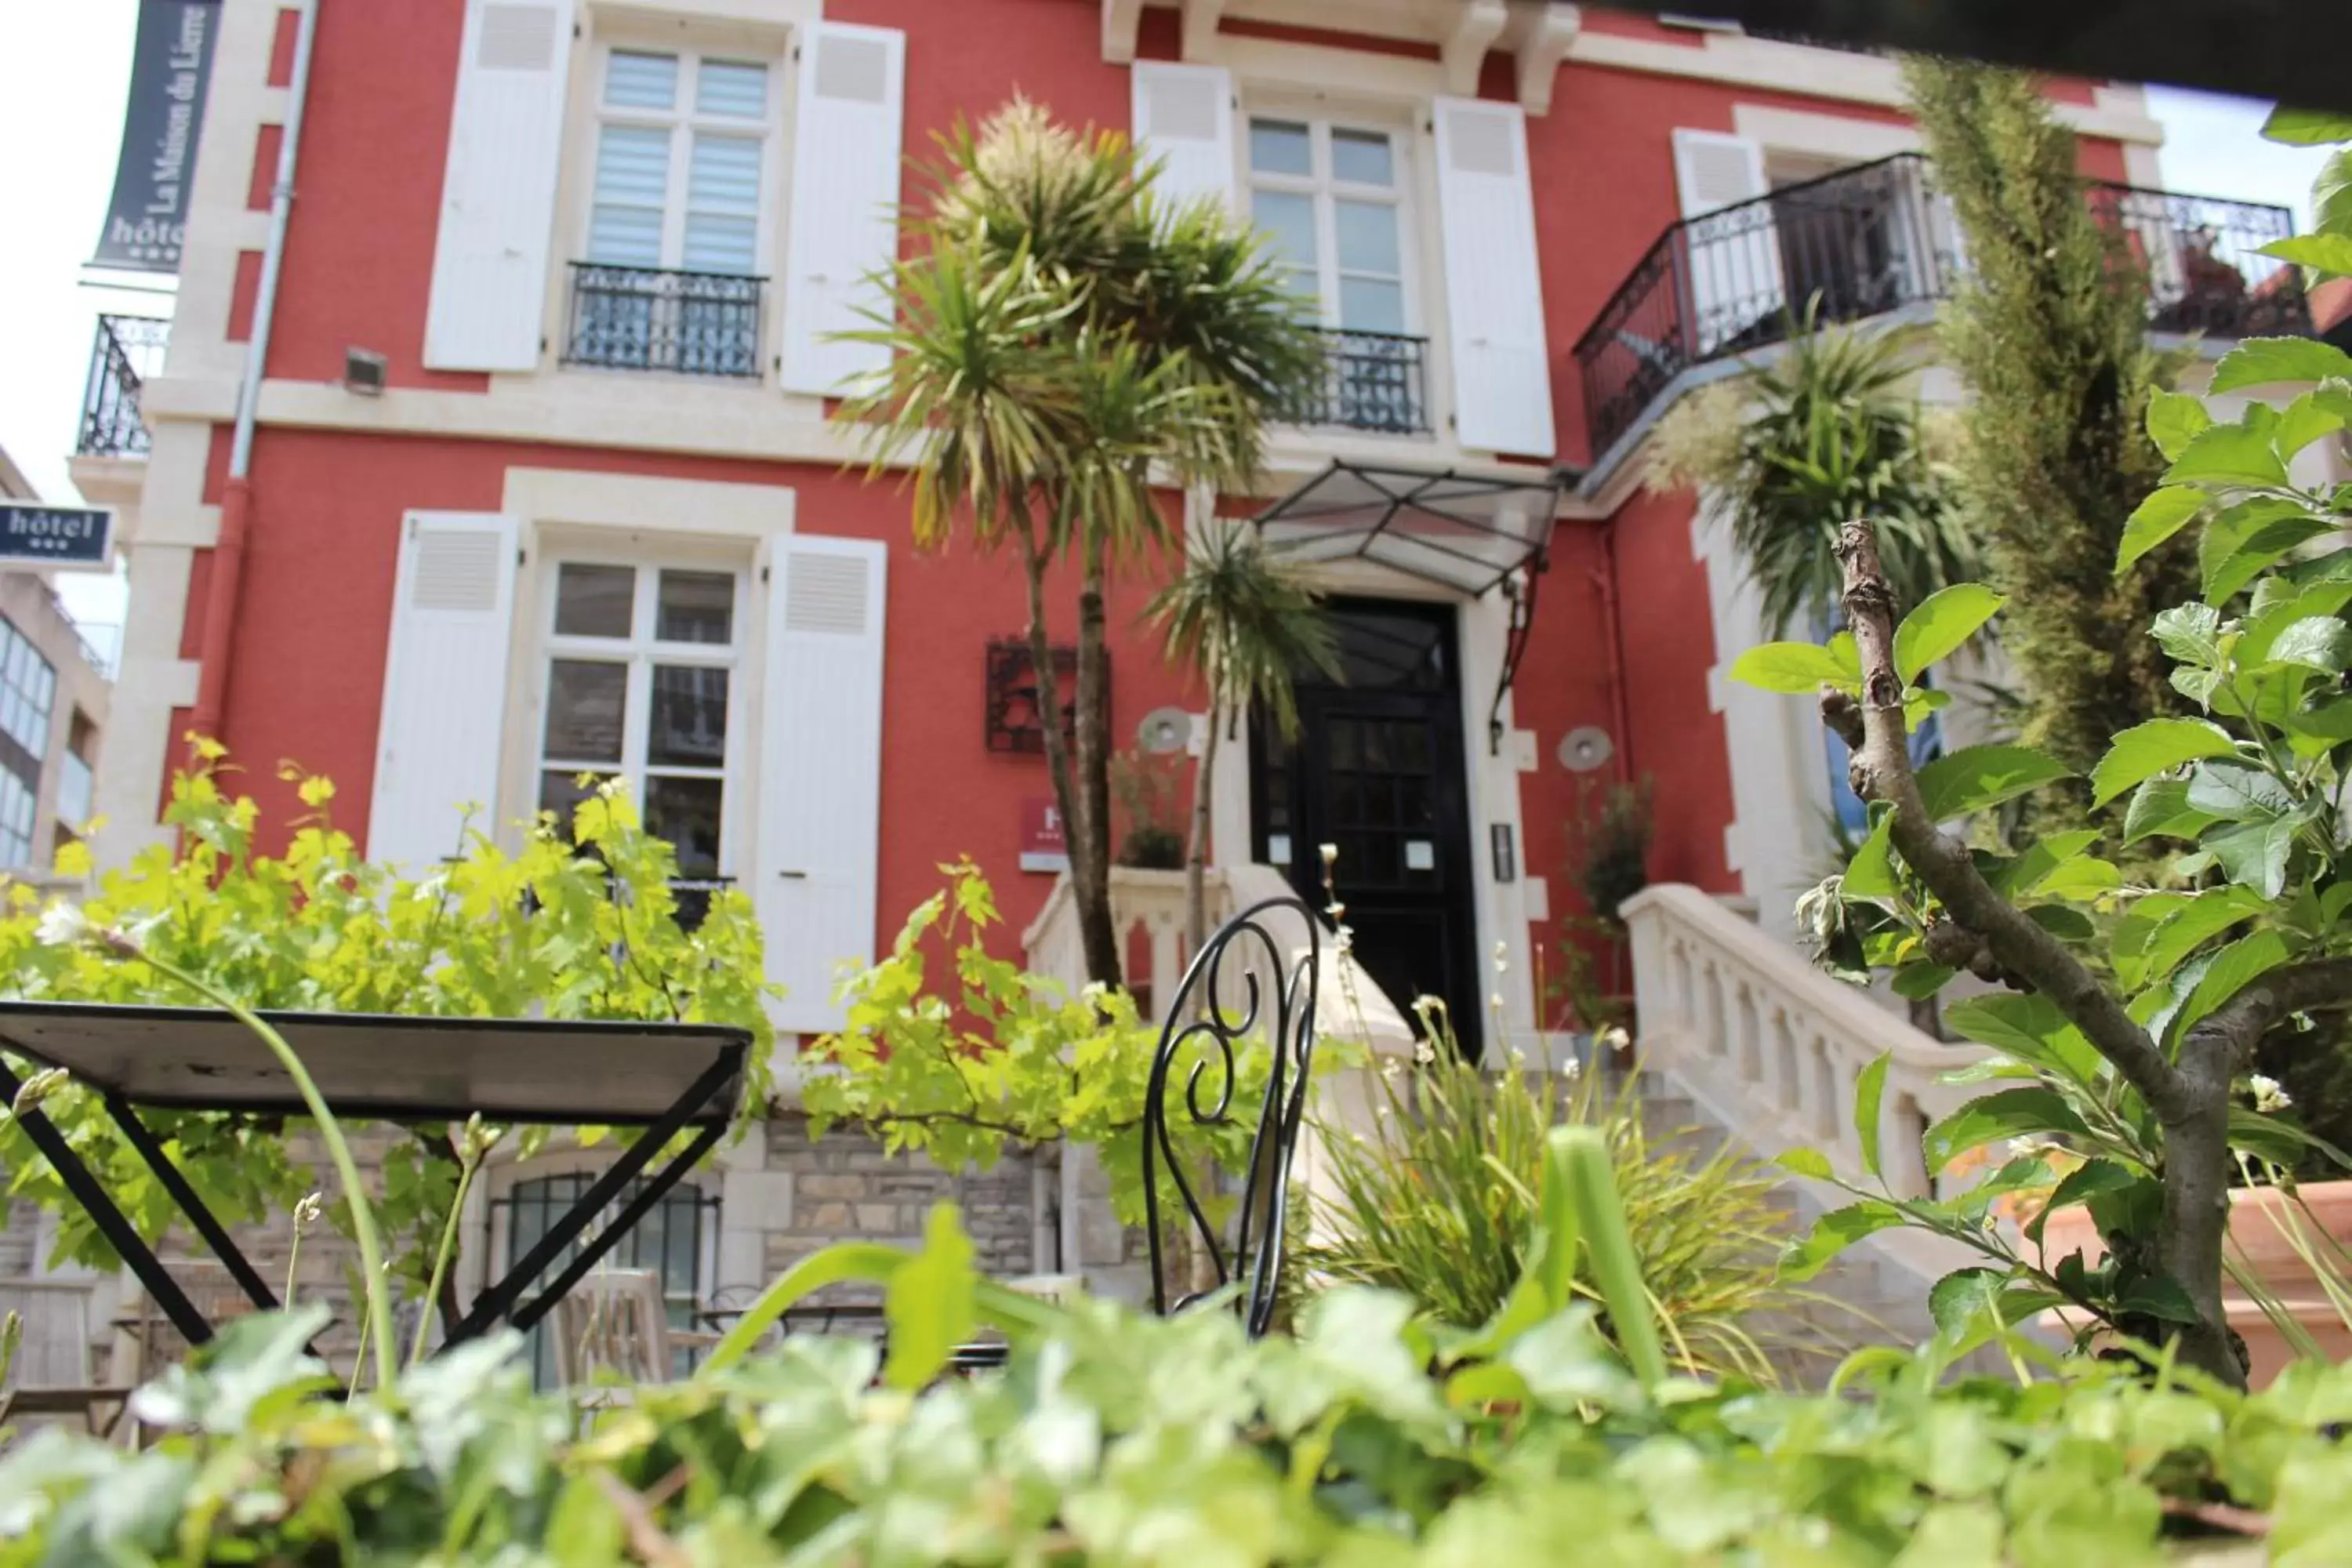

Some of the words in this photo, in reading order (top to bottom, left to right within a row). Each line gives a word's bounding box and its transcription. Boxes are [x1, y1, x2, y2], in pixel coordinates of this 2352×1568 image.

[166, 73, 198, 100] du
[153, 104, 192, 181] Maison
[147, 184, 180, 212] La
[111, 216, 186, 245] hôte
[9, 510, 93, 538] hôtel
